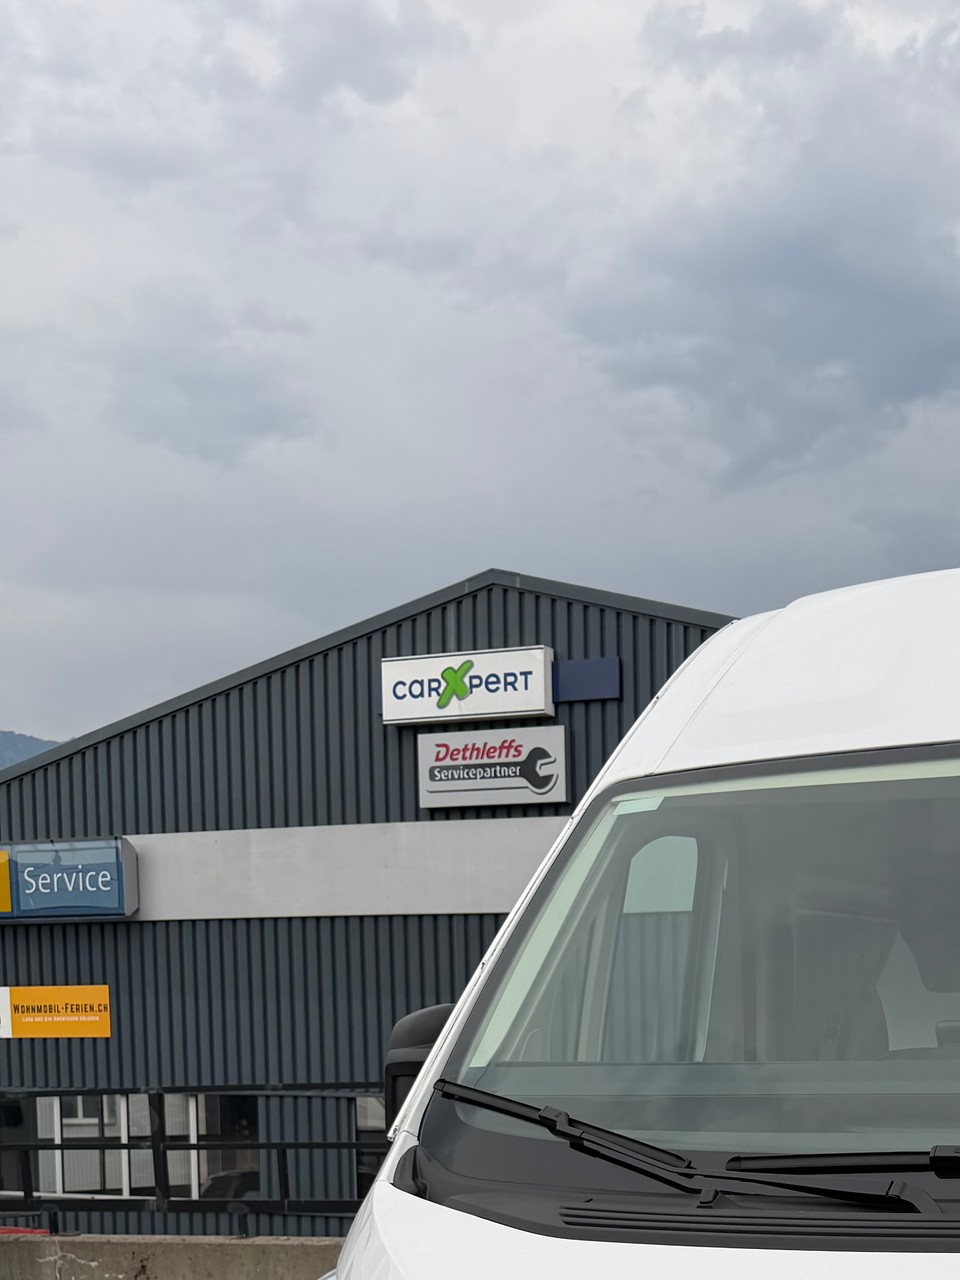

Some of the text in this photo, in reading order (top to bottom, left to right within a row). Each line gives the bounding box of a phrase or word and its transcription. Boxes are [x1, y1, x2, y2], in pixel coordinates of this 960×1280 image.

[434, 739, 523, 762] Dethleffs
[434, 765, 521, 780] Servicepartner
[24, 864, 111, 894] Service
